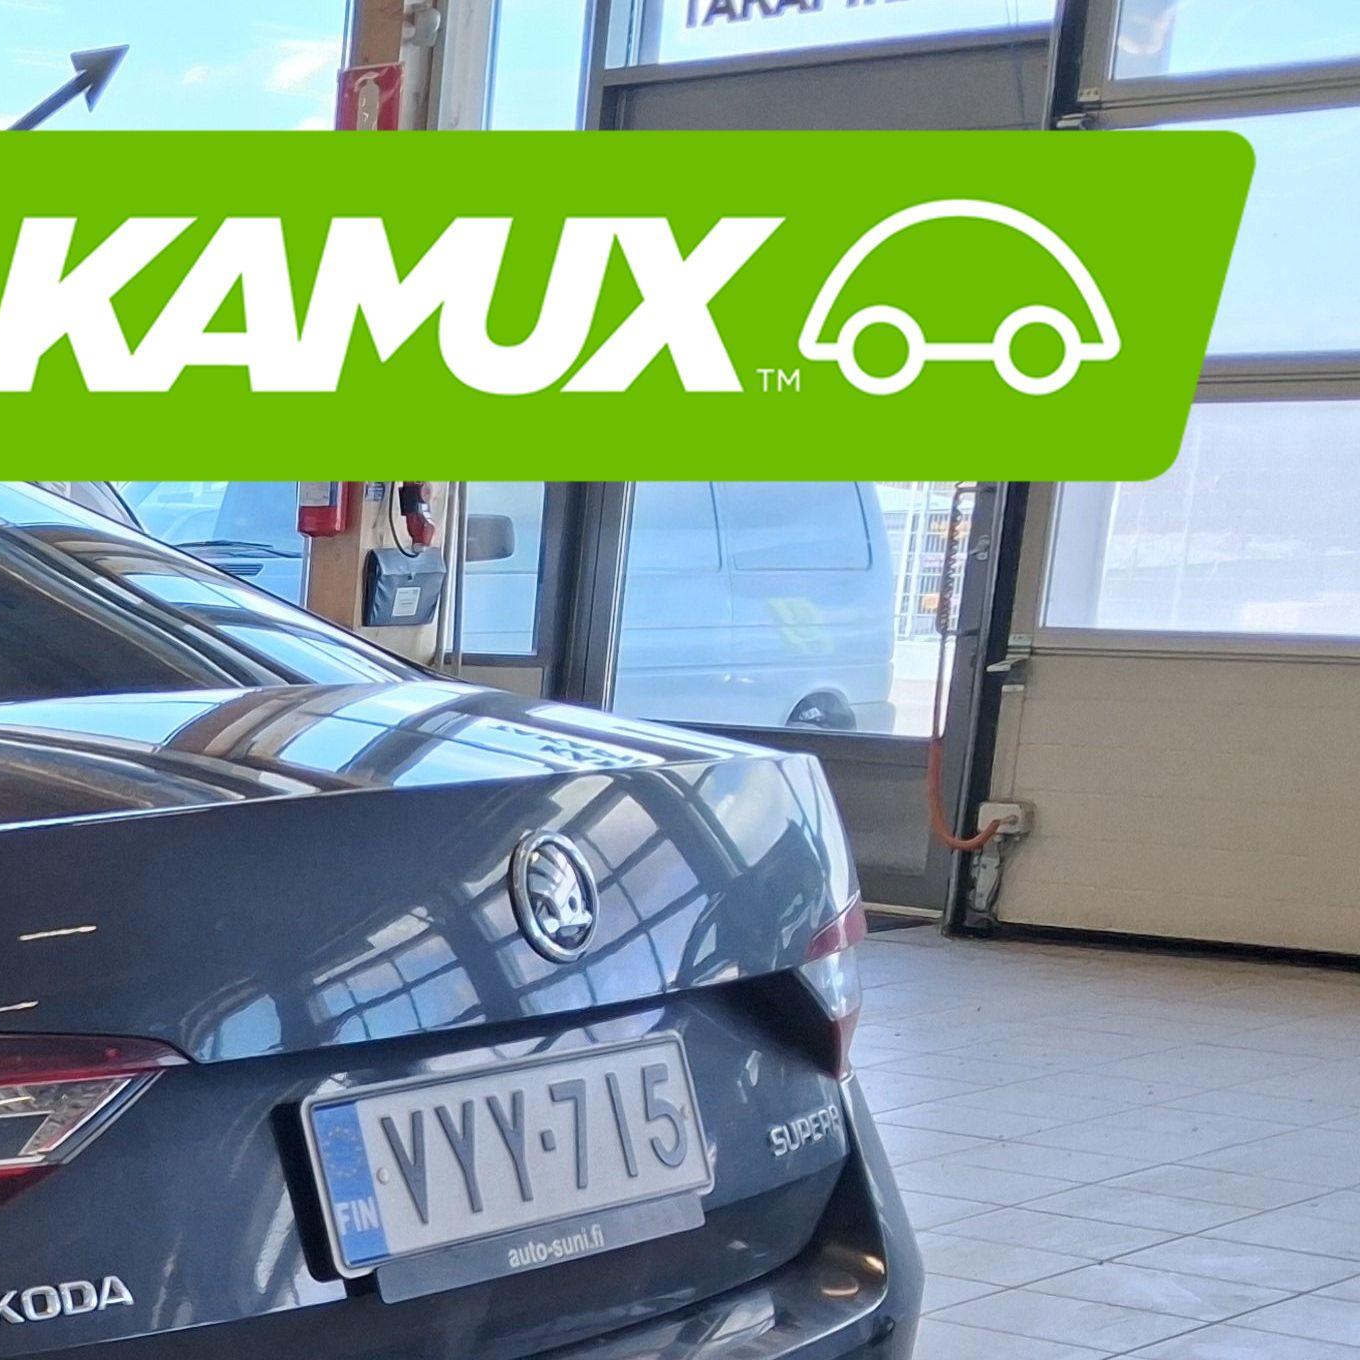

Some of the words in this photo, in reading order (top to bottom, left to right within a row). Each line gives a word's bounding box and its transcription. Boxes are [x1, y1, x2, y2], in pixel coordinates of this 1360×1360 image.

[380, 1062, 688, 1225] VYY-715
[335, 1196, 379, 1237] FIN
[507, 1223, 606, 1269] auto-suni.fi
